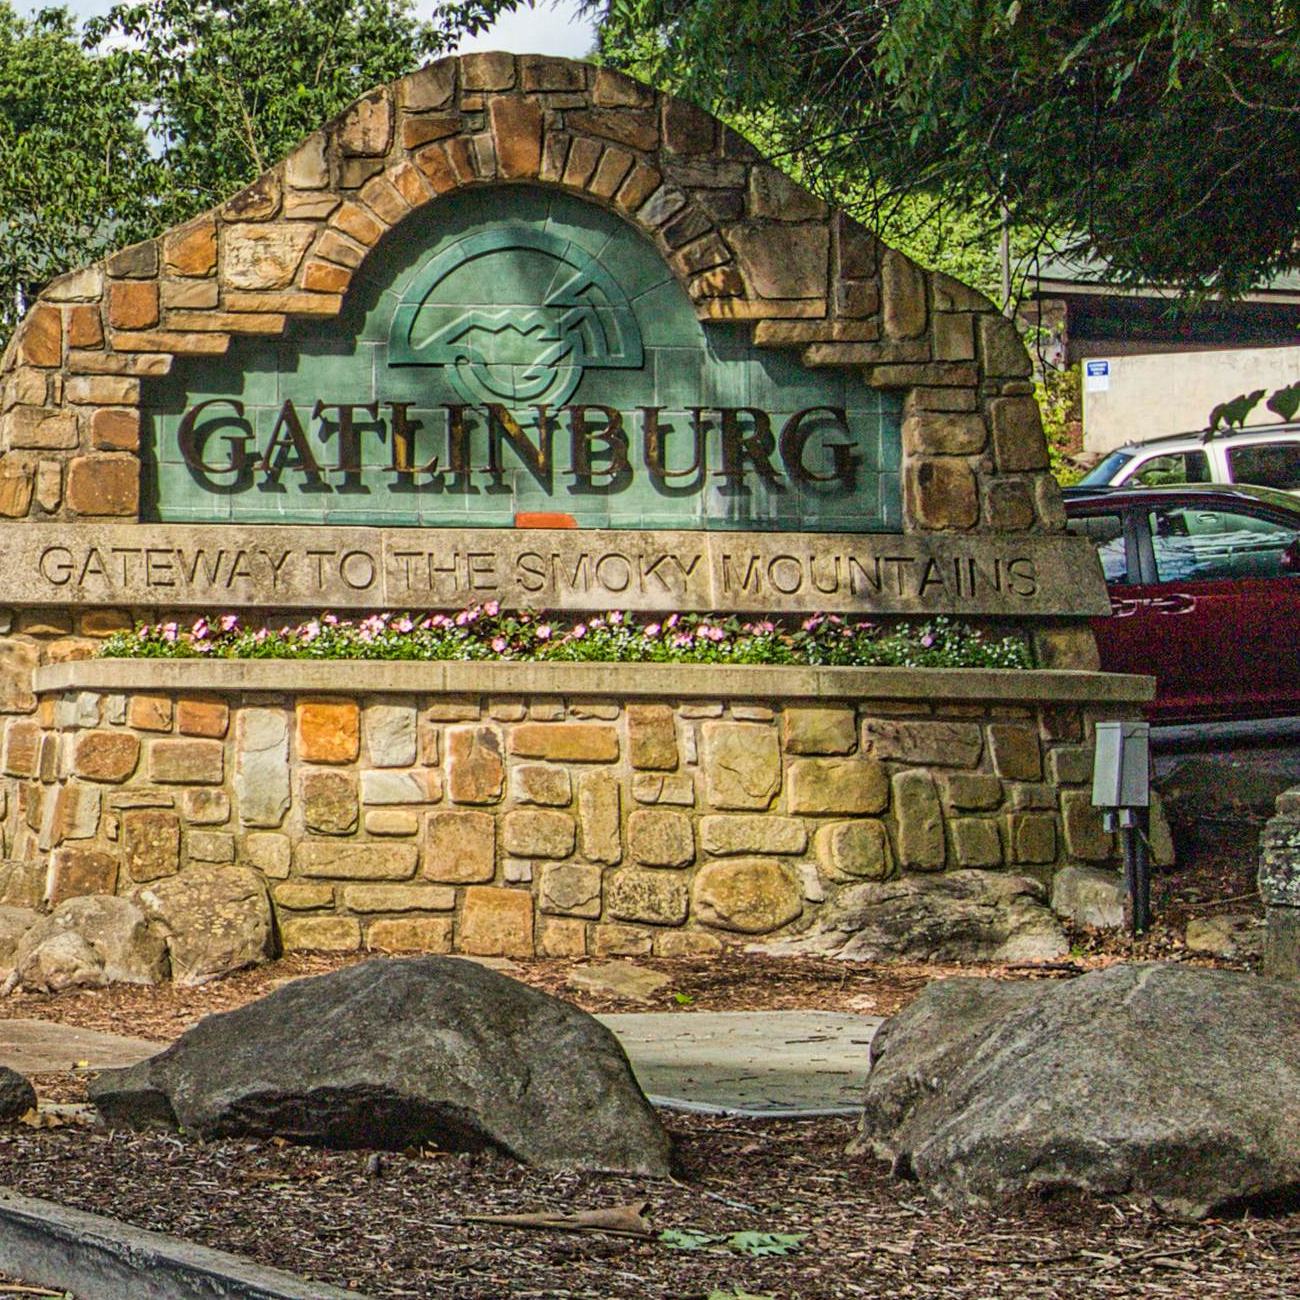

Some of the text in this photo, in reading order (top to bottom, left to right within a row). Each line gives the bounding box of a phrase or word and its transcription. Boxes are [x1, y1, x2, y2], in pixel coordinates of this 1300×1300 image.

[178, 398, 859, 486] GATLINBURG
[39, 546, 1038, 597] GATEWAY TO THE SMOKY MOUNTAINS
